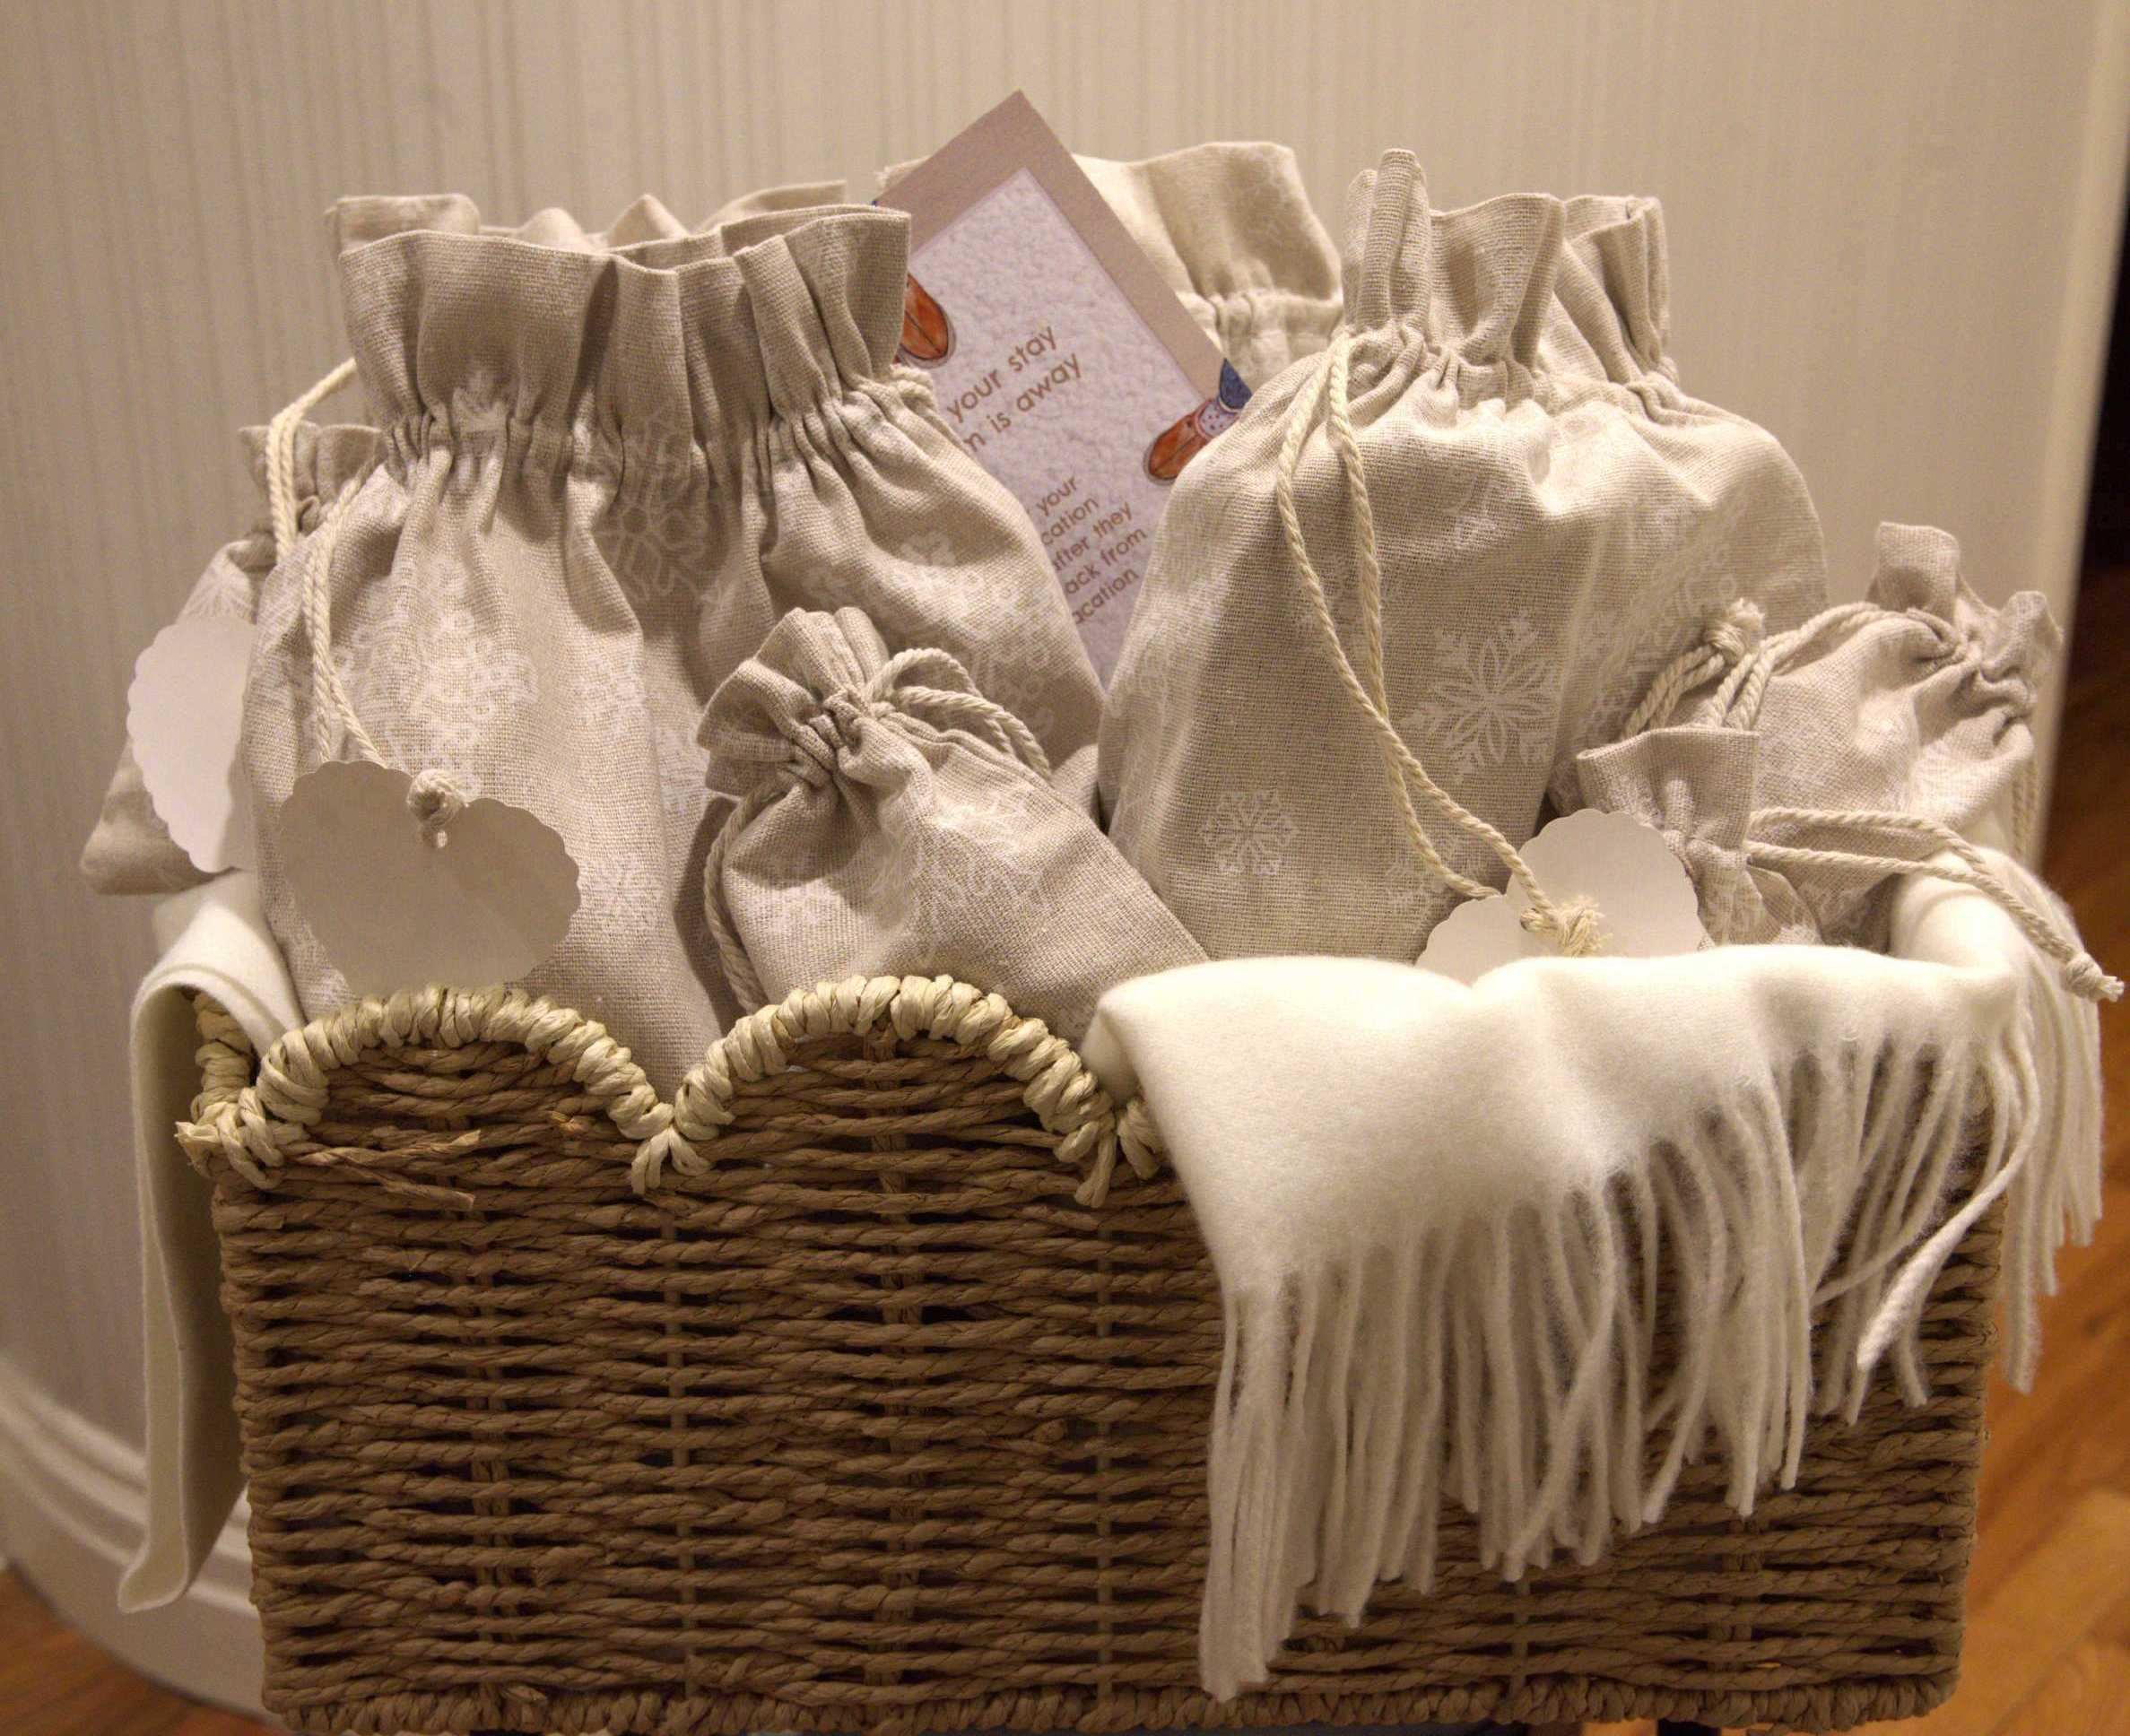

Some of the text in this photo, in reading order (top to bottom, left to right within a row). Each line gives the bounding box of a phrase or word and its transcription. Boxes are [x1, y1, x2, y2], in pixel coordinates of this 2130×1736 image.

[947, 326, 1056, 423] your stay
[987, 412, 1011, 433] is
[1016, 353, 1081, 412] away
[1037, 476, 1077, 516] your
[1041, 499, 1099, 545] cation
[1093, 502, 1132, 538] they
[1065, 529, 1147, 594] ack from
[1073, 569, 1139, 624] acation
